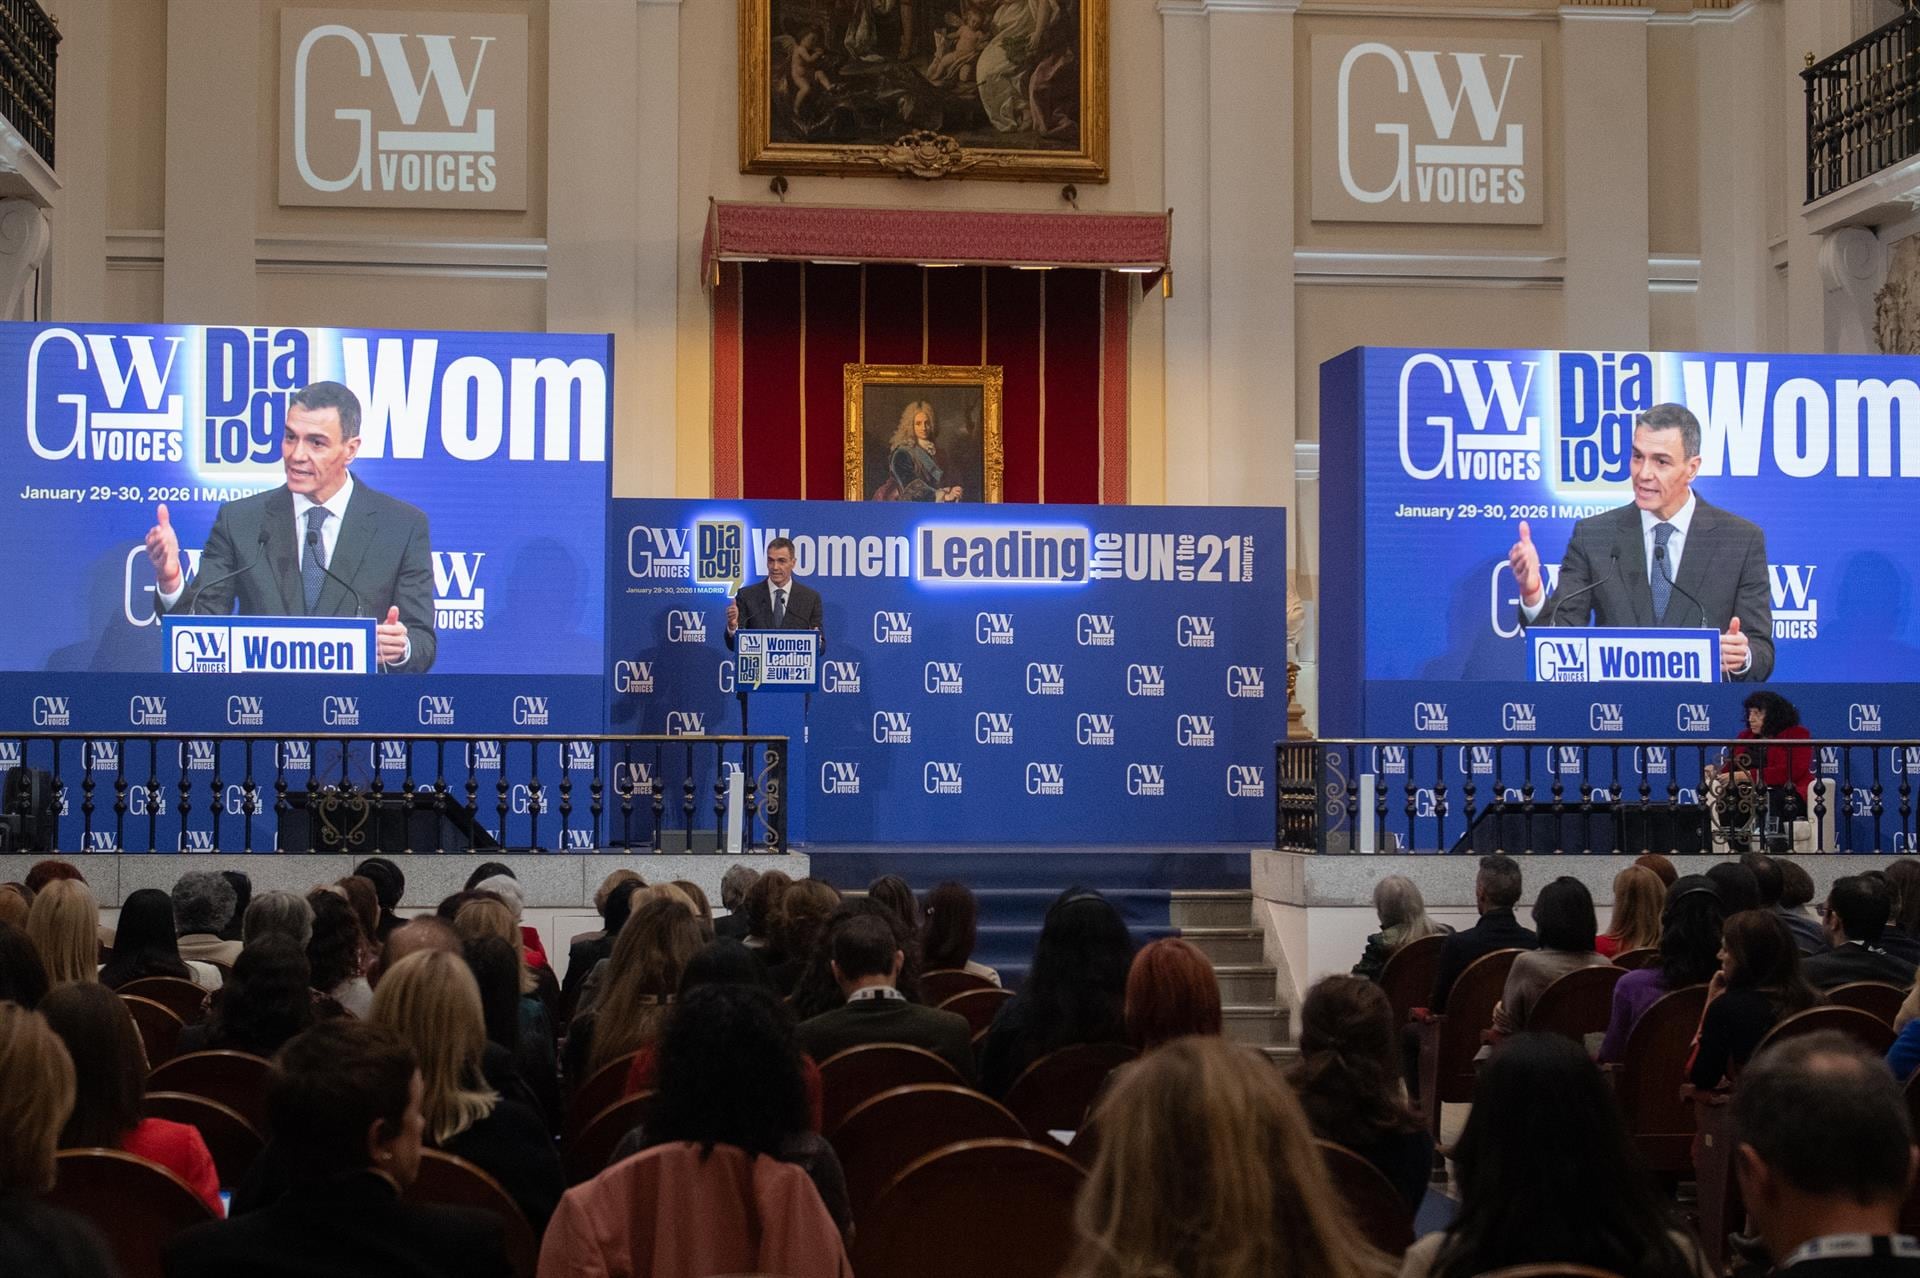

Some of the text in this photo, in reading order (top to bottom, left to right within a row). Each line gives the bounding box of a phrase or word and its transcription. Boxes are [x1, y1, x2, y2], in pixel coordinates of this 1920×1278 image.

[379, 154, 496, 192] VOICES
[1416, 167, 1525, 204] VOICES
[91, 431, 183, 461] VOICES
[1458, 450, 1540, 481] VOICES
[20, 485, 86, 503] January
[90, 486, 143, 503] 29-30,
[148, 486, 190, 501] 2026
[1395, 504, 1452, 520] January
[1457, 504, 1507, 520] 29-30,
[1510, 504, 1548, 519] 2026
[923, 530, 1085, 581] Leading
[1090, 533, 1122, 579] the
[1125, 533, 1174, 581] UN
[654, 566, 690, 578] VOICES
[626, 587, 652, 595] January
[1771, 621, 1817, 639] OICES
[684, 634, 706, 642] VOICES
[890, 635, 912, 643] VOICES
[992, 636, 1013, 644] VOICES
[1193, 639, 1214, 647] VOICES
[767, 637, 811, 651] Women
[243, 635, 354, 670] Women
[767, 652, 811, 666] Leading
[1599, 646, 1700, 679] Women
[197, 662, 226, 673] VOICES
[776, 668, 789, 680] UN
[1558, 672, 1584, 681] VOICES
[631, 684, 653, 692] VOICES
[1143, 688, 1164, 696] VOICES
[890, 735, 911, 743] VOICES
[992, 736, 1013, 744] VOICES
[1093, 737, 1114, 745] VOICES
[633, 786, 652, 794] OICES
[1243, 789, 1264, 797] VOICES
